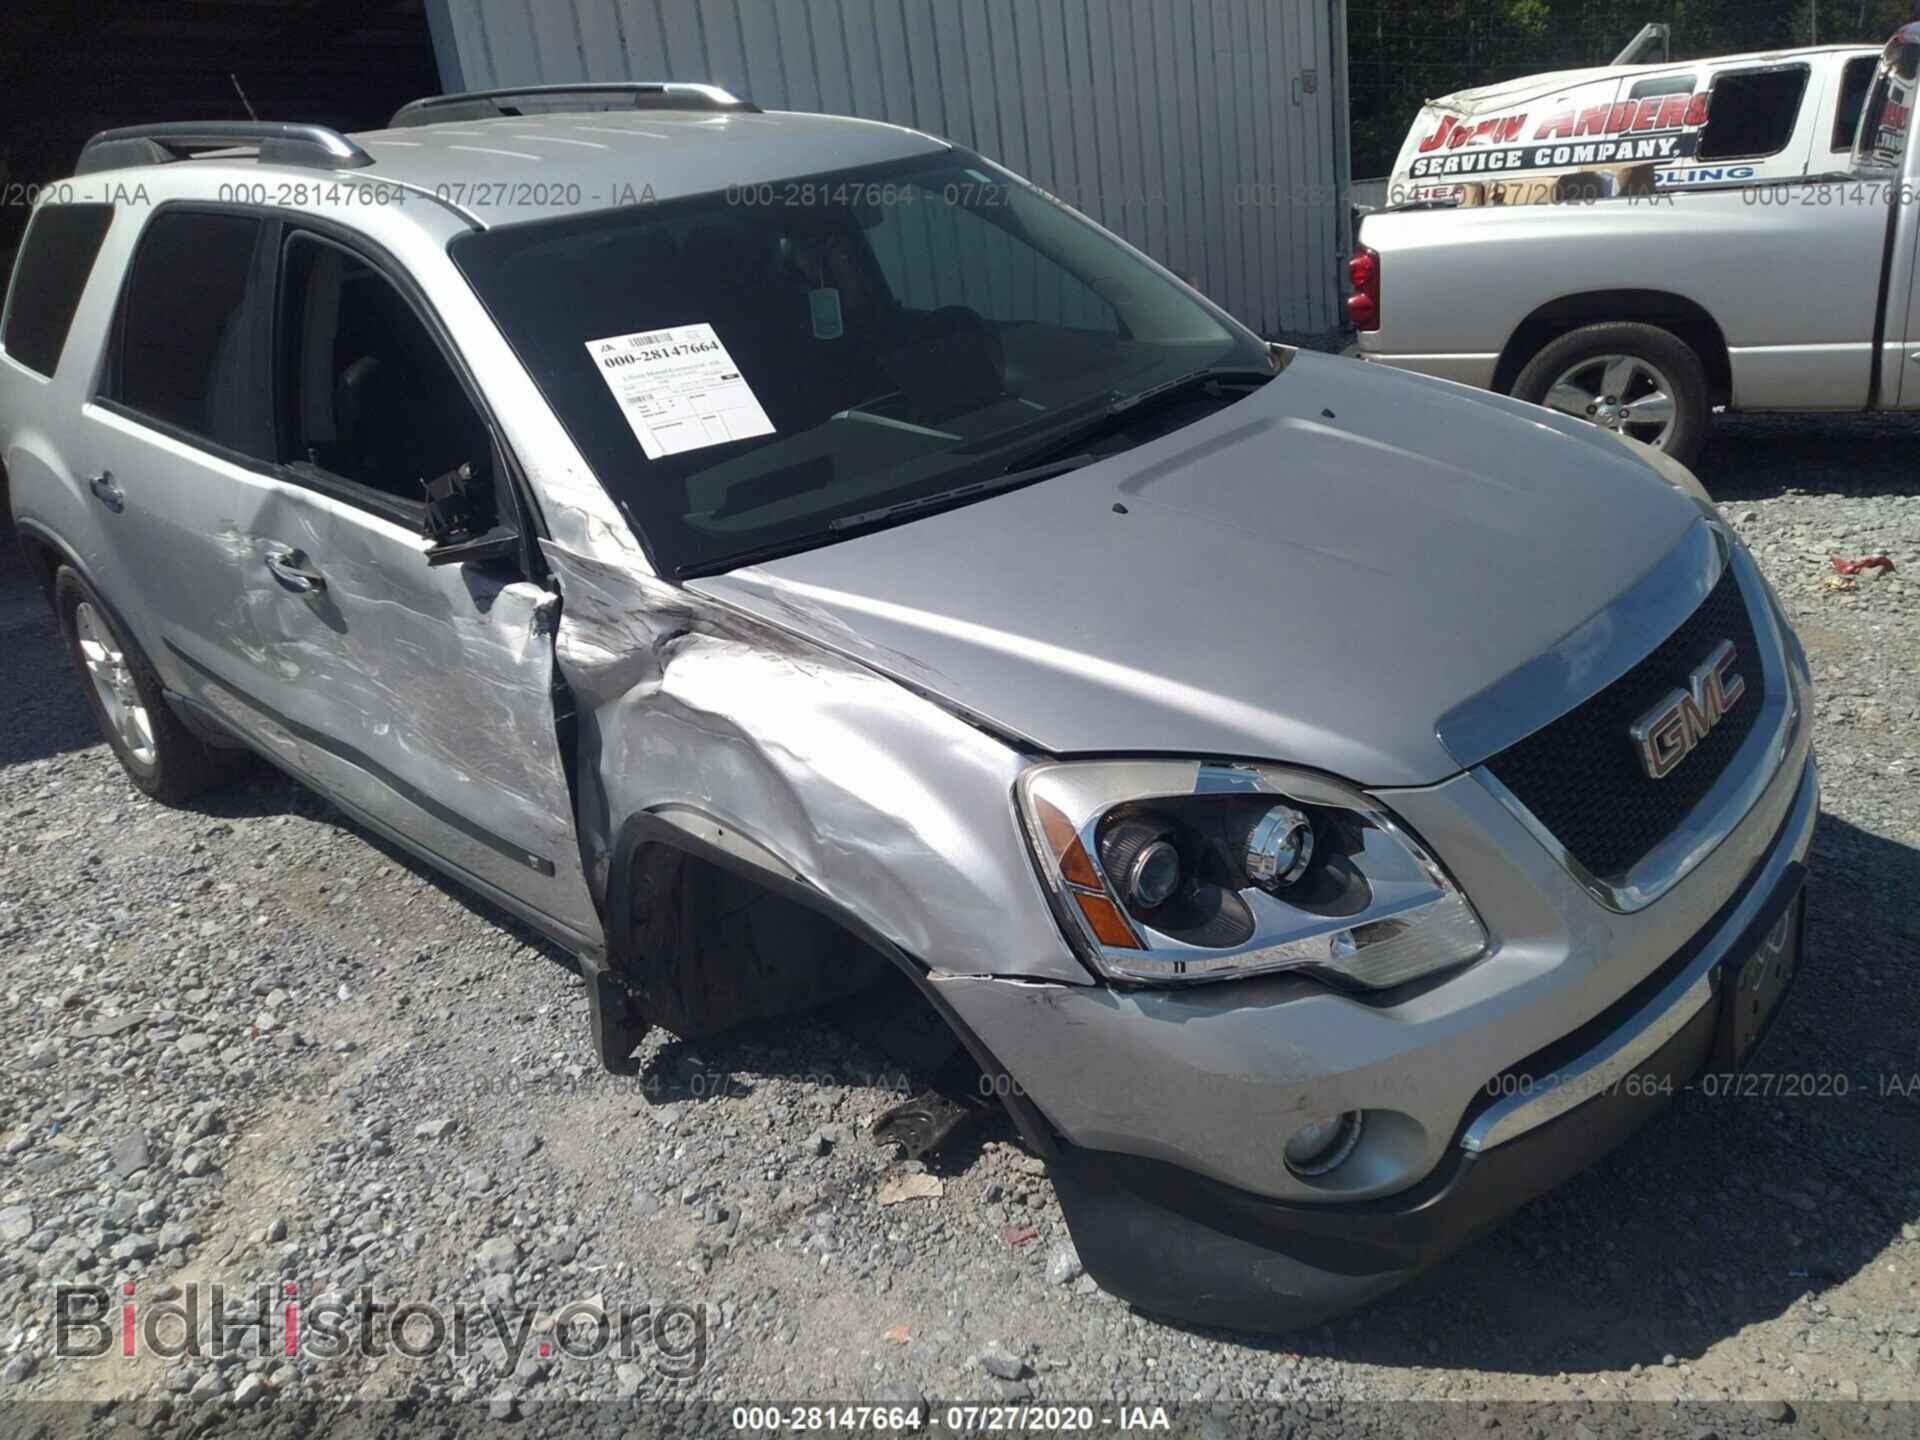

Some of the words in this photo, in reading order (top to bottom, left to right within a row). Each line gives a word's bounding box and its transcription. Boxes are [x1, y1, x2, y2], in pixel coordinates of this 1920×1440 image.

[1413, 150, 1522, 176] SERVICE
[1533, 137, 1681, 166] COMPANY,
[604, 341, 719, 369] 000-28147664
[1632, 640, 1745, 779] GMC
